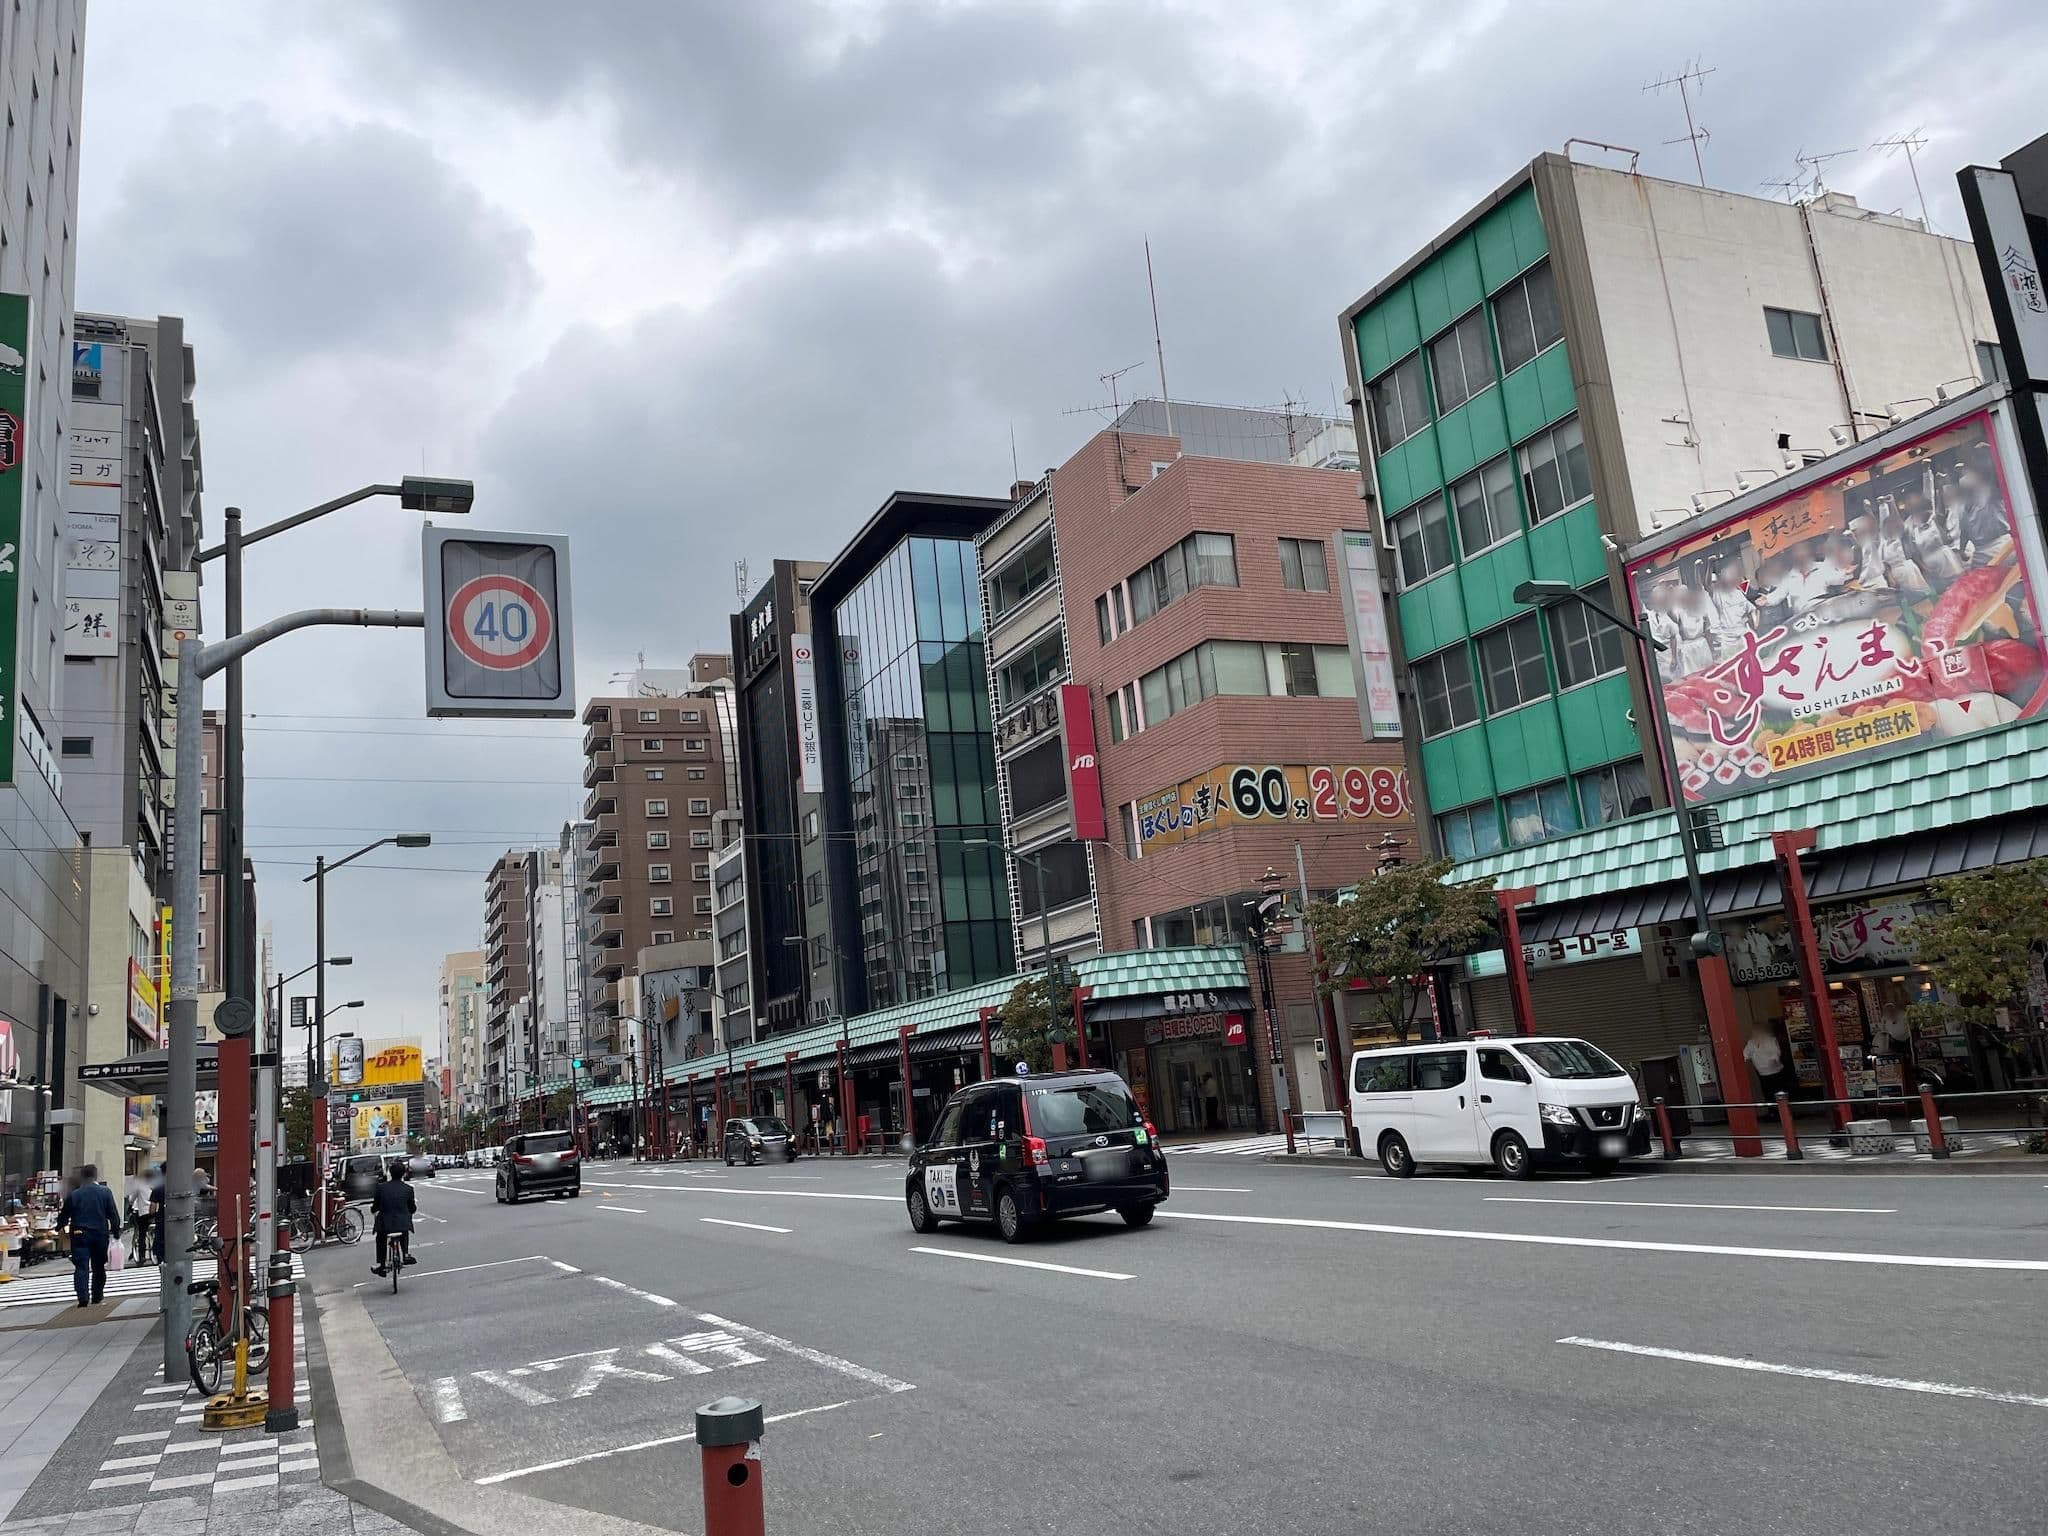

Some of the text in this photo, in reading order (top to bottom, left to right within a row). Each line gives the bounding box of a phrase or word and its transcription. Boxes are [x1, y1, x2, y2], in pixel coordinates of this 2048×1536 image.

[70, 463, 112, 477] ヨガ
[474, 601, 528, 642] 40
[1793, 678, 1902, 718] SUSHIZANMAI
[1071, 754, 1095, 771] JTB
[1140, 783, 1230, 841] ほぐしの達人
[1227, 1024, 1242, 1037] JTB
[930, 1169, 943, 1183] TAXI
